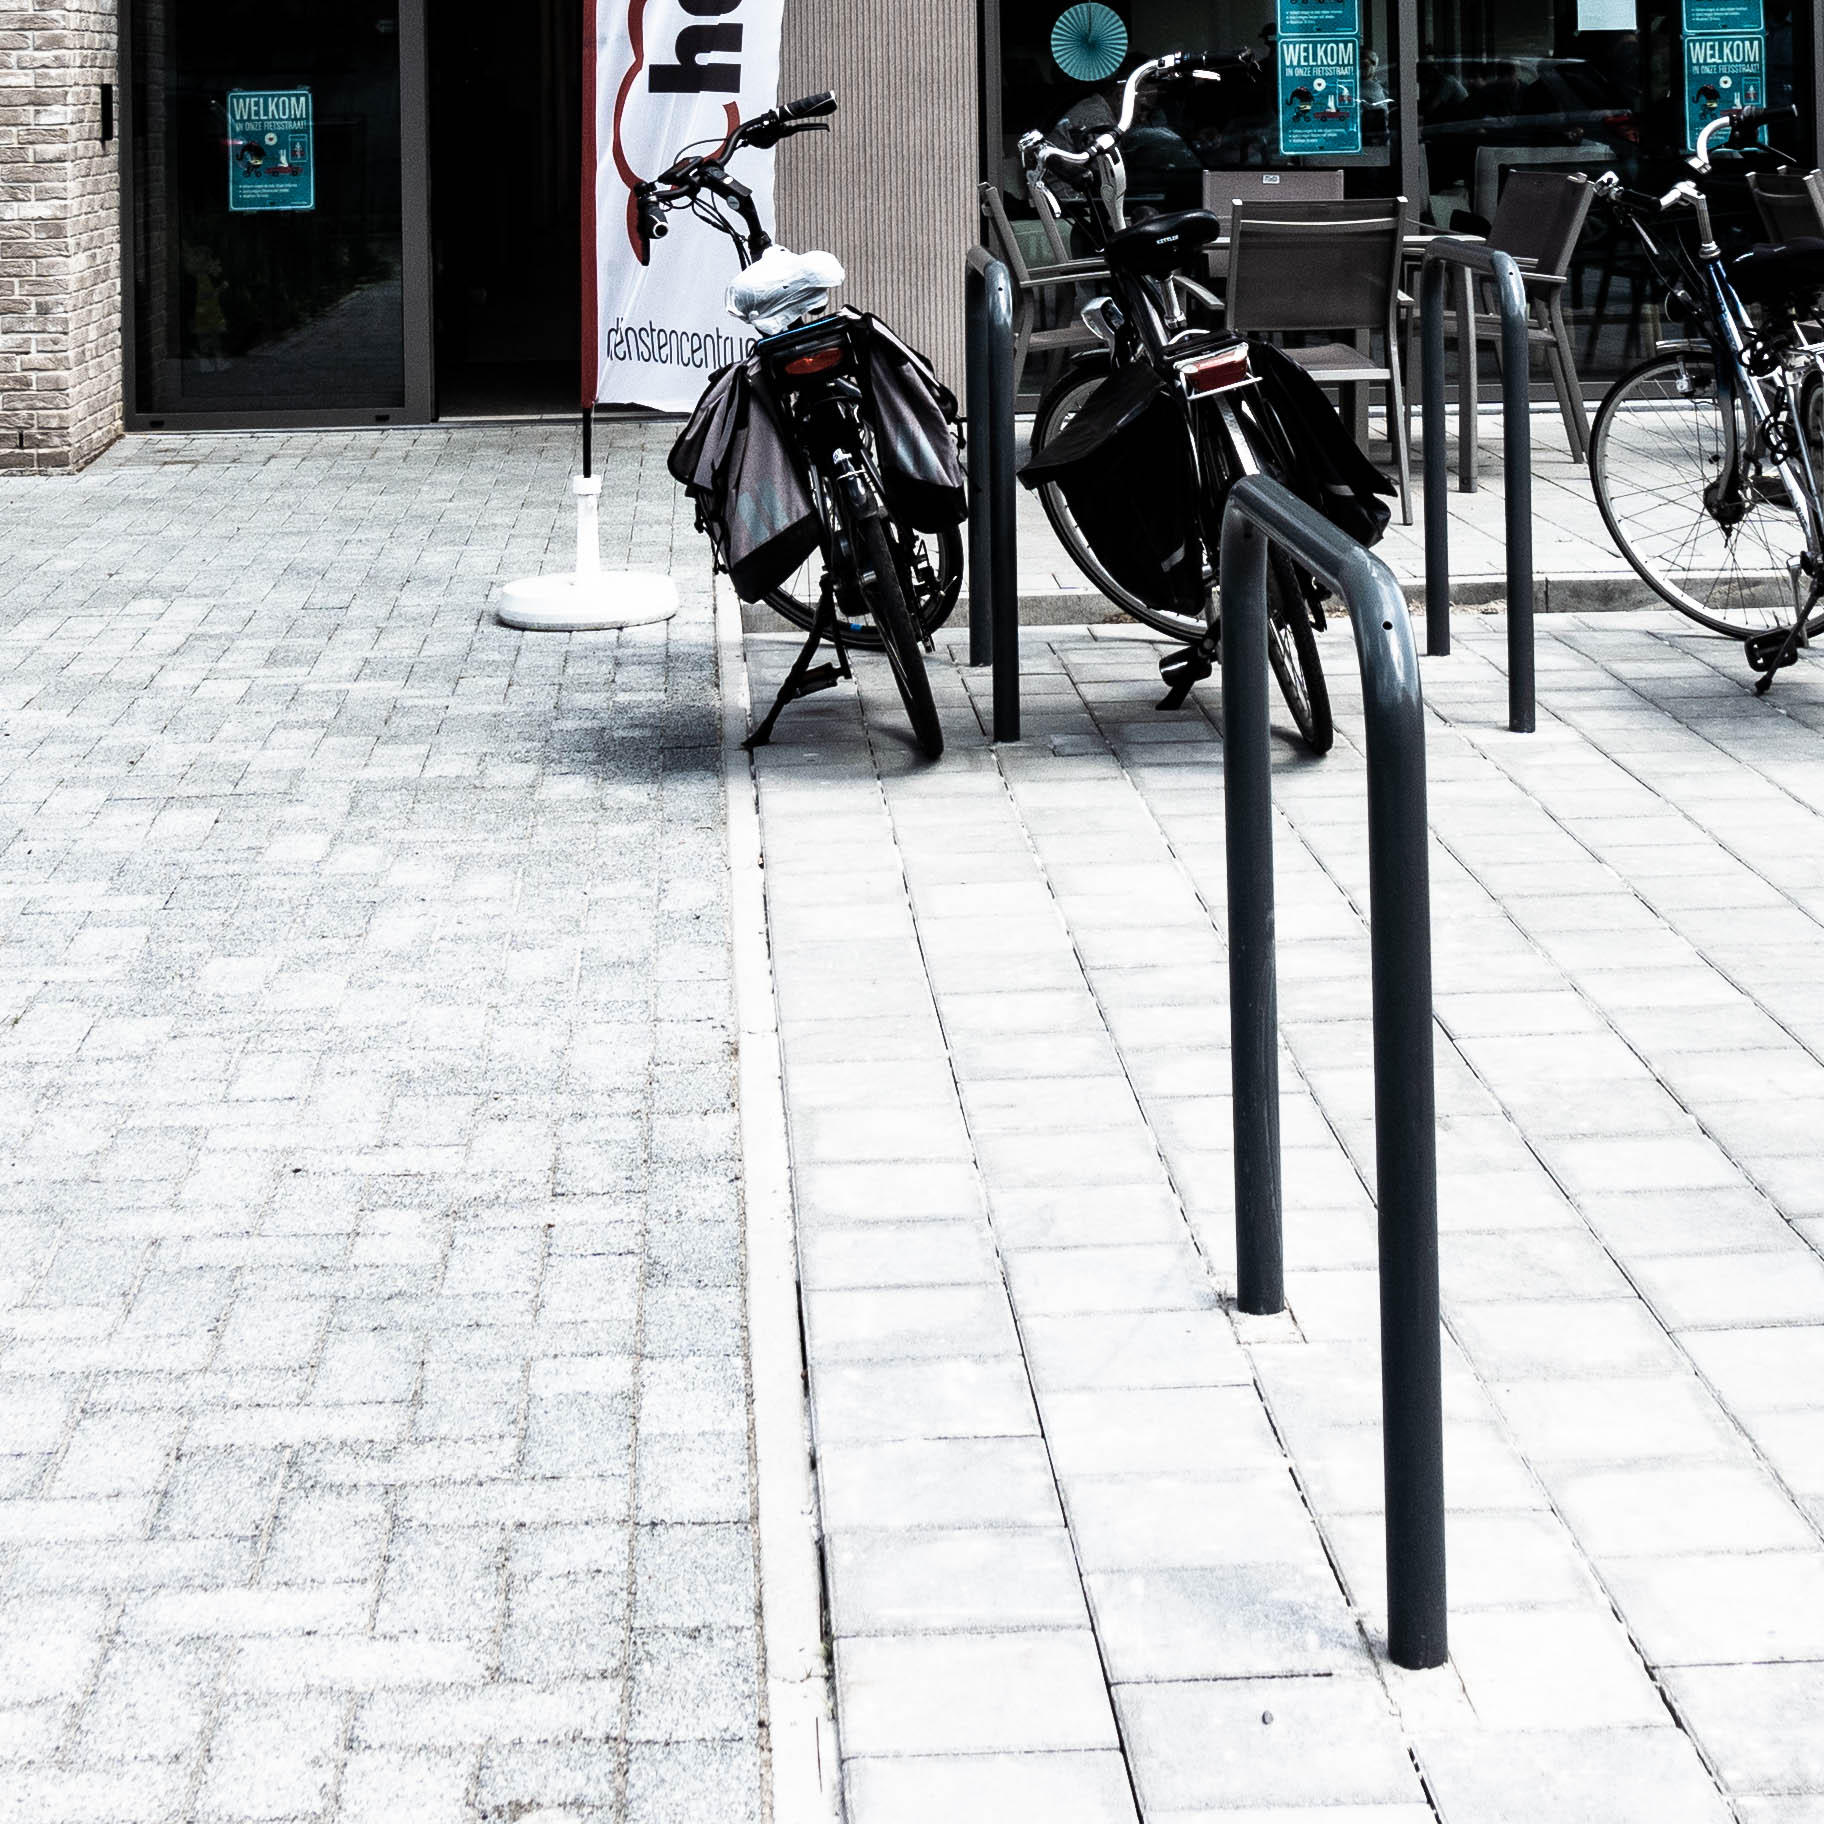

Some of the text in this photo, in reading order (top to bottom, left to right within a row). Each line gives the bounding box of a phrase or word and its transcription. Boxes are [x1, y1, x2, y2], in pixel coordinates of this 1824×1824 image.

[1283, 42, 1354, 66] WELKOM
[1689, 40, 1760, 64] WELKOM
[233, 96, 307, 121] WELKOM
